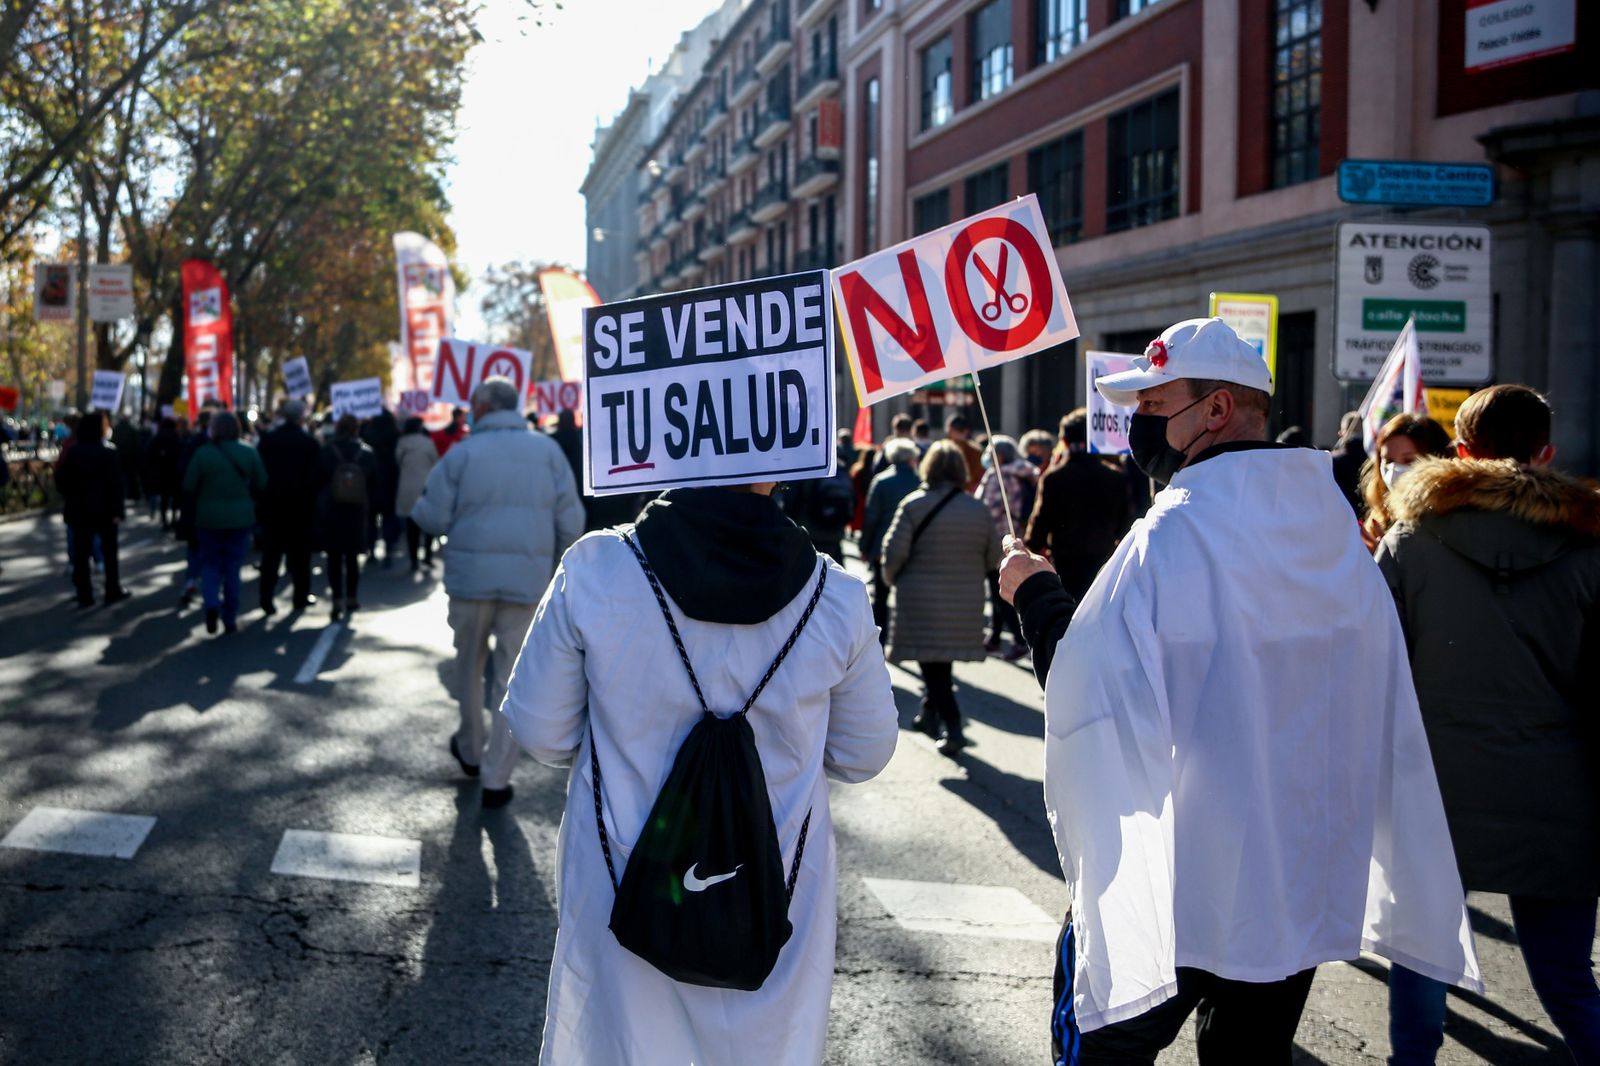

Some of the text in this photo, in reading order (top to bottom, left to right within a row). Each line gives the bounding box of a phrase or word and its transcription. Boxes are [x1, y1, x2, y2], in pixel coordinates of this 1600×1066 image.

[1479, 3, 1535, 27] COLEGIO
[1378, 165, 1489, 182] Distrito Centro
[1349, 232, 1483, 251] ATENCIÓN
[839, 216, 1055, 395] NO
[593, 284, 823, 371] SE VENDE
[432, 340, 524, 403] NO
[400, 391, 429, 410] NO
[536, 382, 579, 414] NO
[601, 368, 821, 467] TU SALUD.
[1091, 408, 1122, 437] otros,
